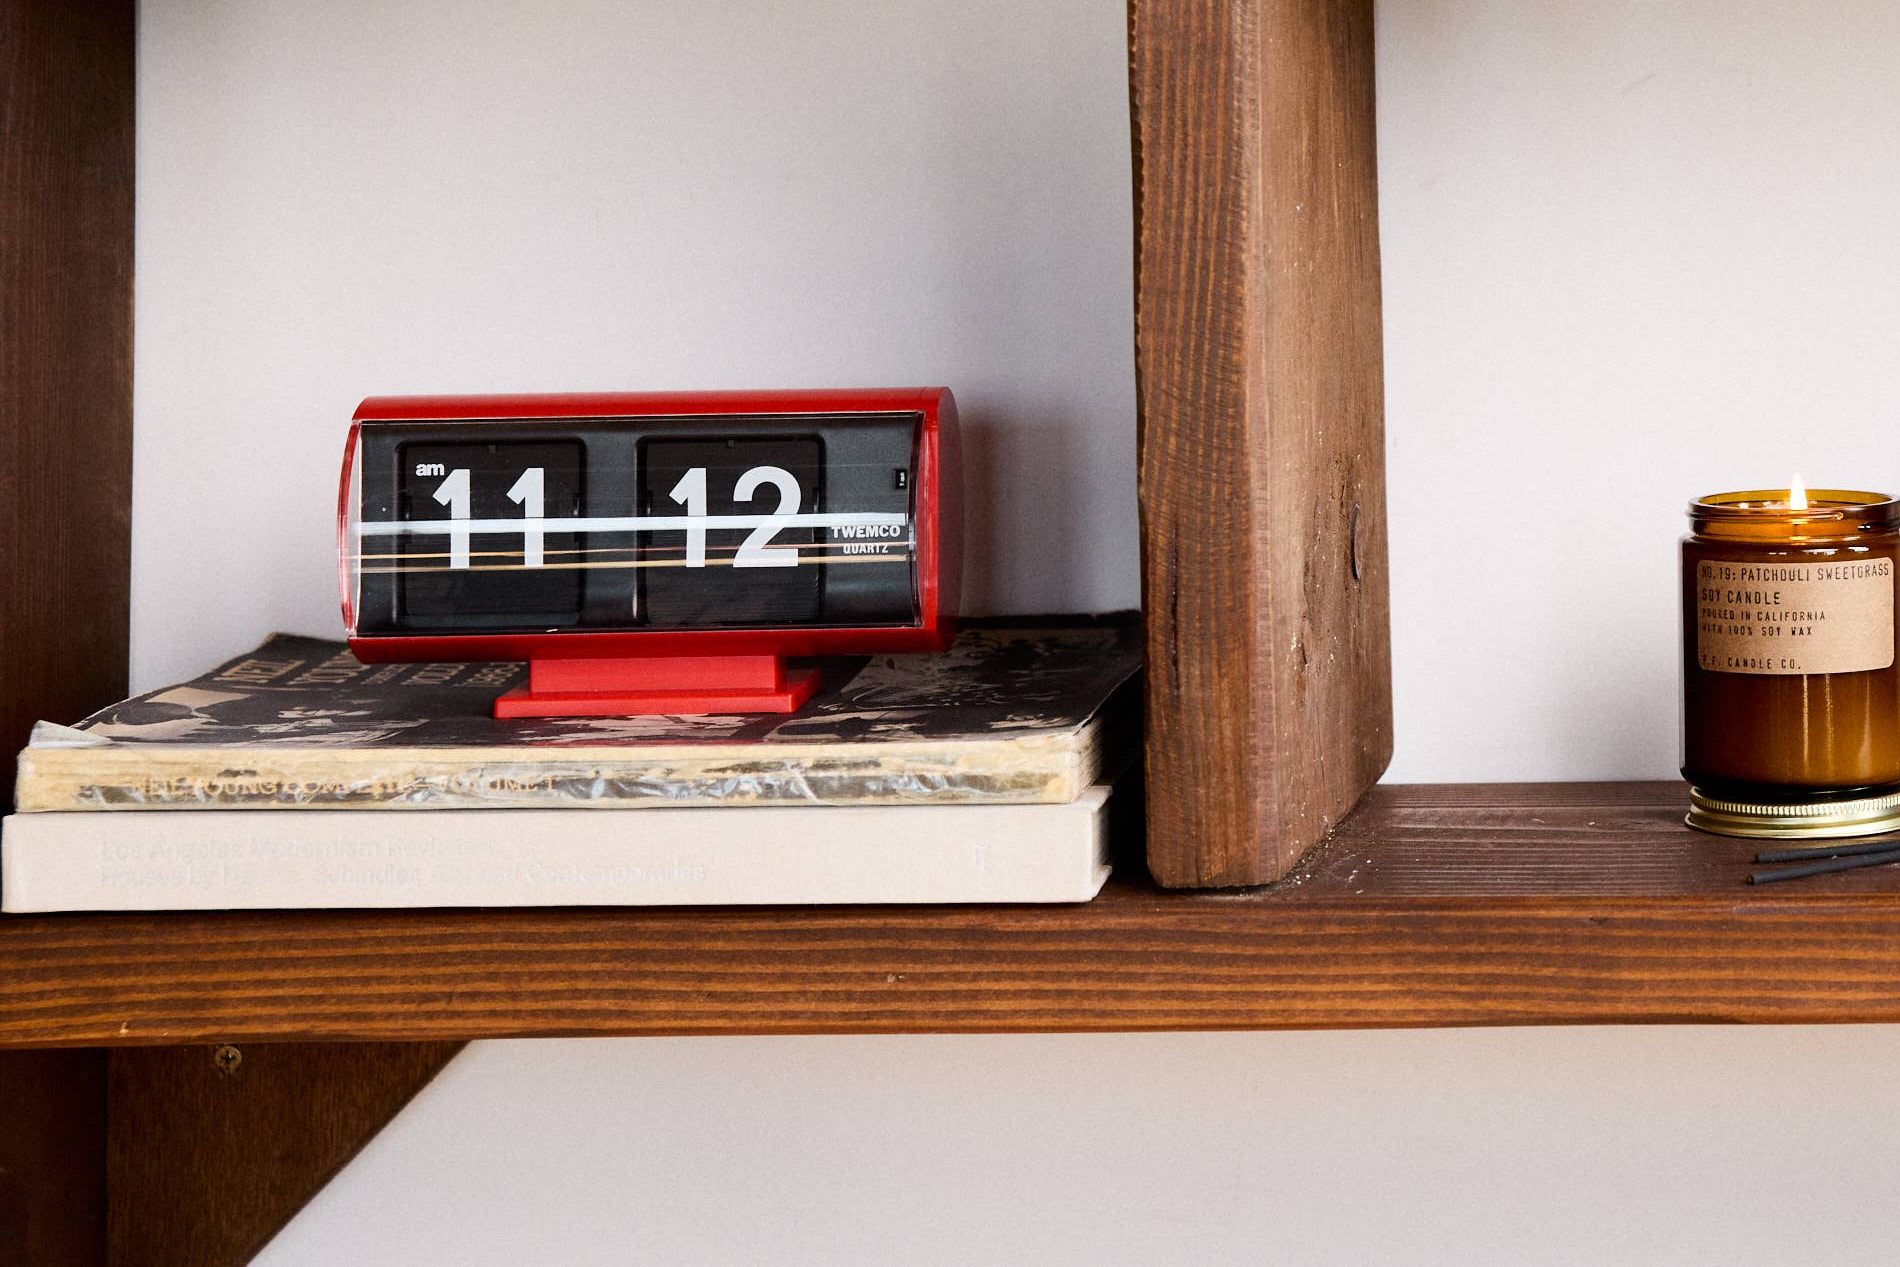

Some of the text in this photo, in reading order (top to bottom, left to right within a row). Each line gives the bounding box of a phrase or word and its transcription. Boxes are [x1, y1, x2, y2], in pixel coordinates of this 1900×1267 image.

[416, 460, 445, 477] am
[432, 466, 801, 570] 11 12
[831, 525, 900, 539] TWEMCO
[843, 543, 888, 554] QUARTZ
[1741, 568, 1809, 582] PATCHOULI
[1817, 563, 1889, 580] SWEETGRASS
[1702, 588, 1781, 605] SOY CANDLE
[1702, 608, 1826, 621] POURED IN CALIFORNIA
[1702, 623, 1813, 636] WITH 100% SOY WAX
[1727, 657, 1772, 669] CANDLE
